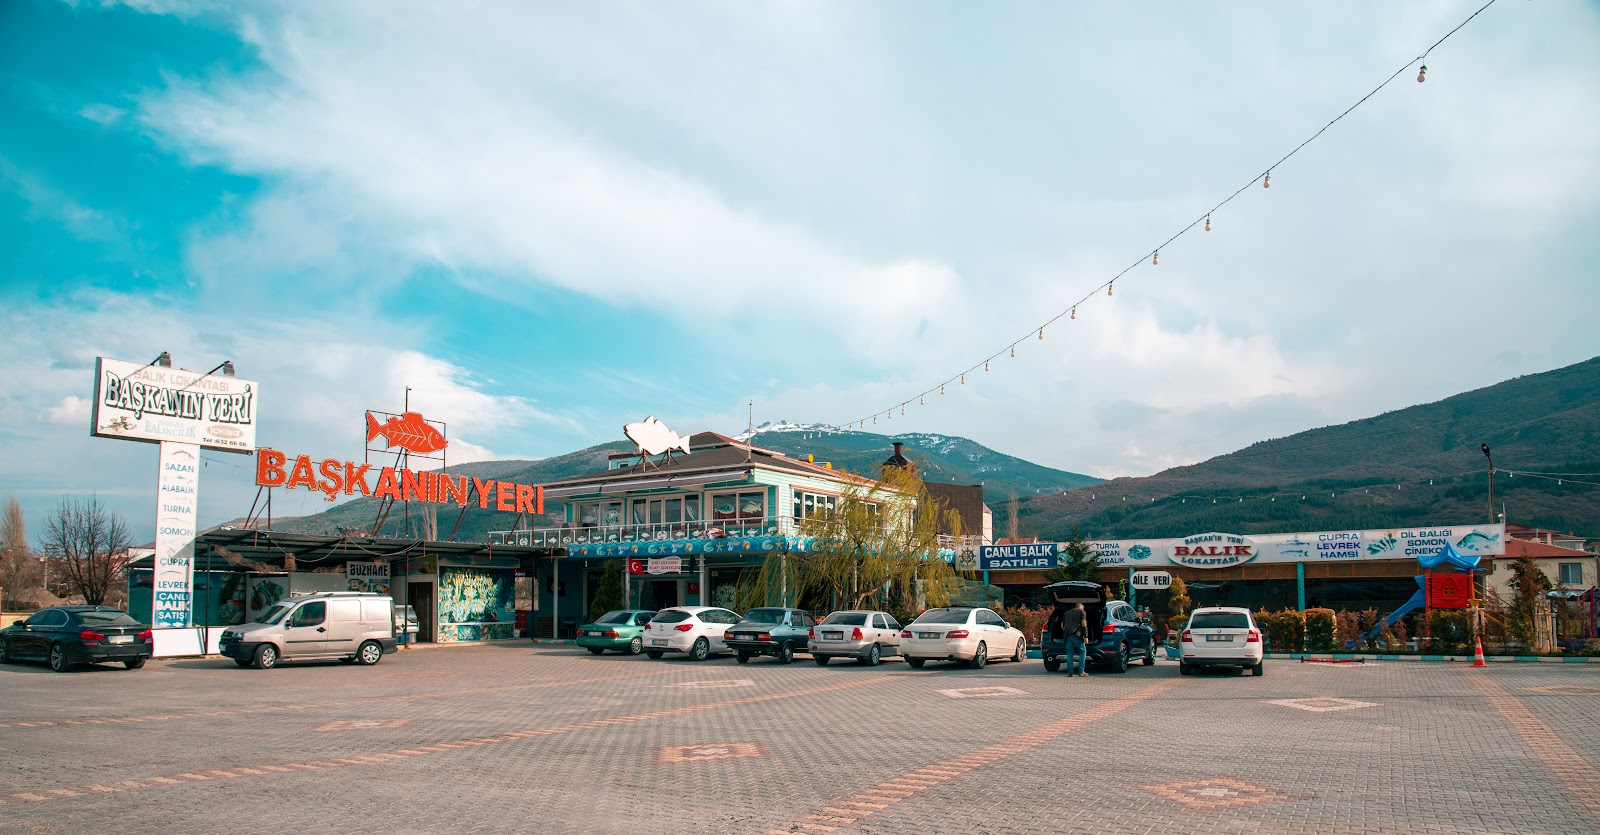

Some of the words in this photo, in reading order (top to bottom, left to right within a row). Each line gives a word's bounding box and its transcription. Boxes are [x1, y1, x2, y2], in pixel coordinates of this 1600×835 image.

[134, 370, 166, 384] BALIK
[170, 373, 230, 392] LOKANTASI
[105, 370, 205, 420] BAŞKANIN
[207, 384, 252, 424] YERİ
[164, 463, 195, 473] SAZAN
[255, 448, 468, 507] BAŞKANIN
[161, 484, 195, 494] ALABALIK
[163, 504, 192, 514] TURNA
[159, 526, 193, 536] SOMON
[1419, 529, 1452, 538] BALIĞI
[1318, 533, 1359, 543] ÇUPRA
[1407, 539, 1446, 547] SOMON
[1174, 545, 1252, 556] BALIK
[1316, 542, 1361, 550] LEVREK
[984, 546, 1017, 559] CANLI
[1020, 544, 1053, 557] BALIK
[1320, 550, 1359, 558] HAMSİ
[1404, 547, 1443, 556] ÇİNEKO
[160, 557, 190, 569] ÇUPRA
[989, 558, 1049, 568] SATILIR
[1181, 556, 1240, 565] LOKANTASI
[1132, 573, 1149, 585] AİLE
[1153, 574, 1170, 586] YERİ
[158, 581, 189, 589] LEVREK
[158, 592, 189, 600] CANLI
[156, 600, 191, 611] BALIK
